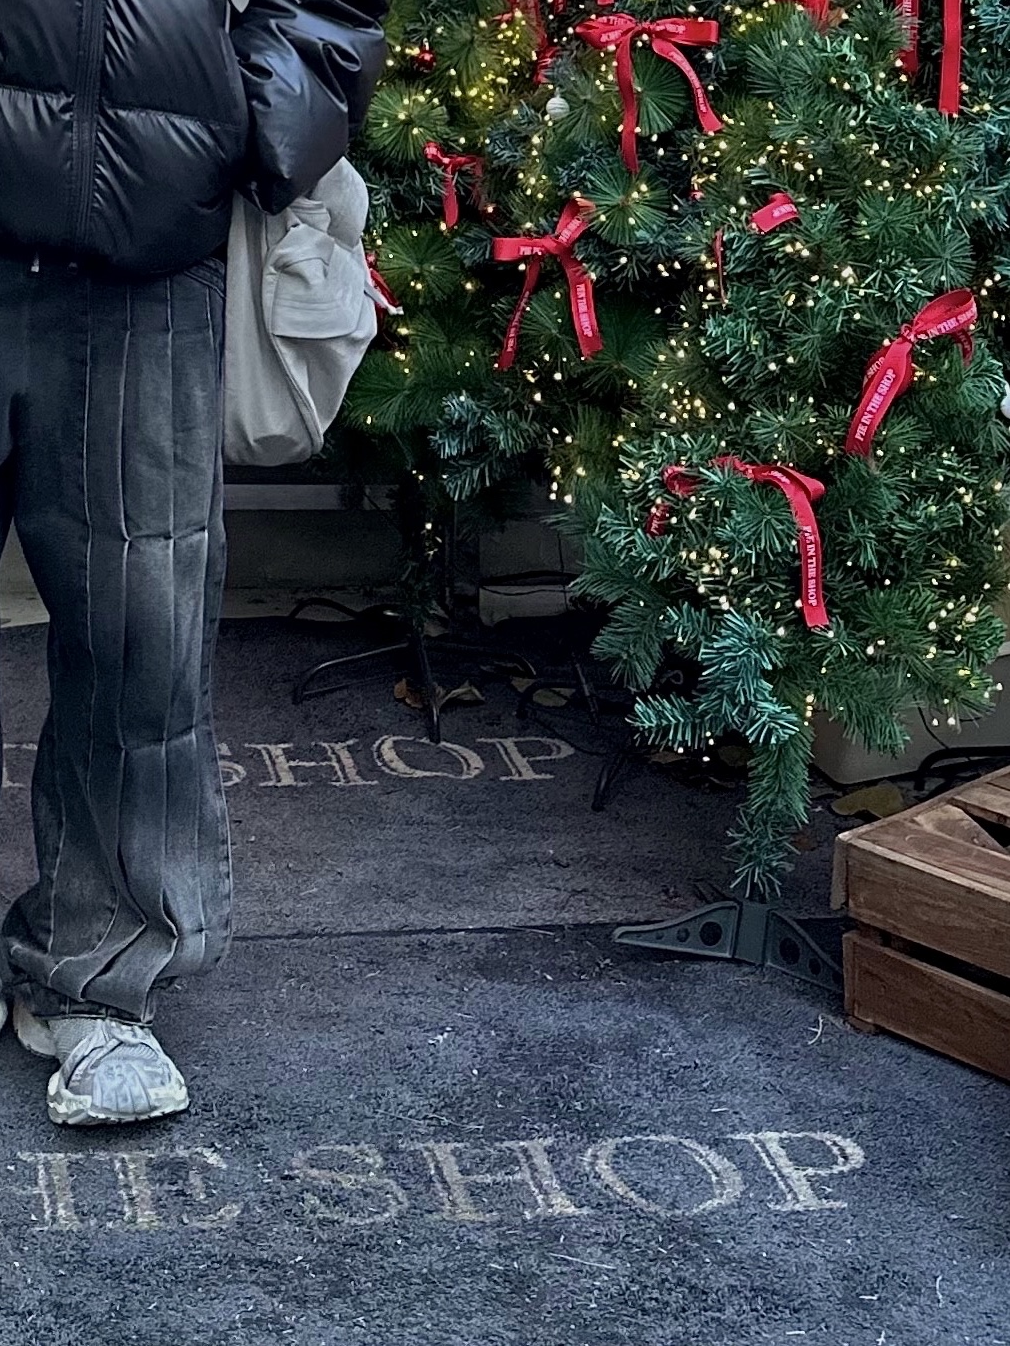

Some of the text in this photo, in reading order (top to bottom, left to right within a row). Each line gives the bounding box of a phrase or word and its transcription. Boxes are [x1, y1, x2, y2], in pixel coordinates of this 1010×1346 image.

[854, 368, 896, 442] PIE IN THE SHOP
[806, 545, 817, 555] IN
[807, 556, 818, 578] THE
[807, 579, 818, 607] SHOP
[293, 1129, 865, 1232] SHOP
